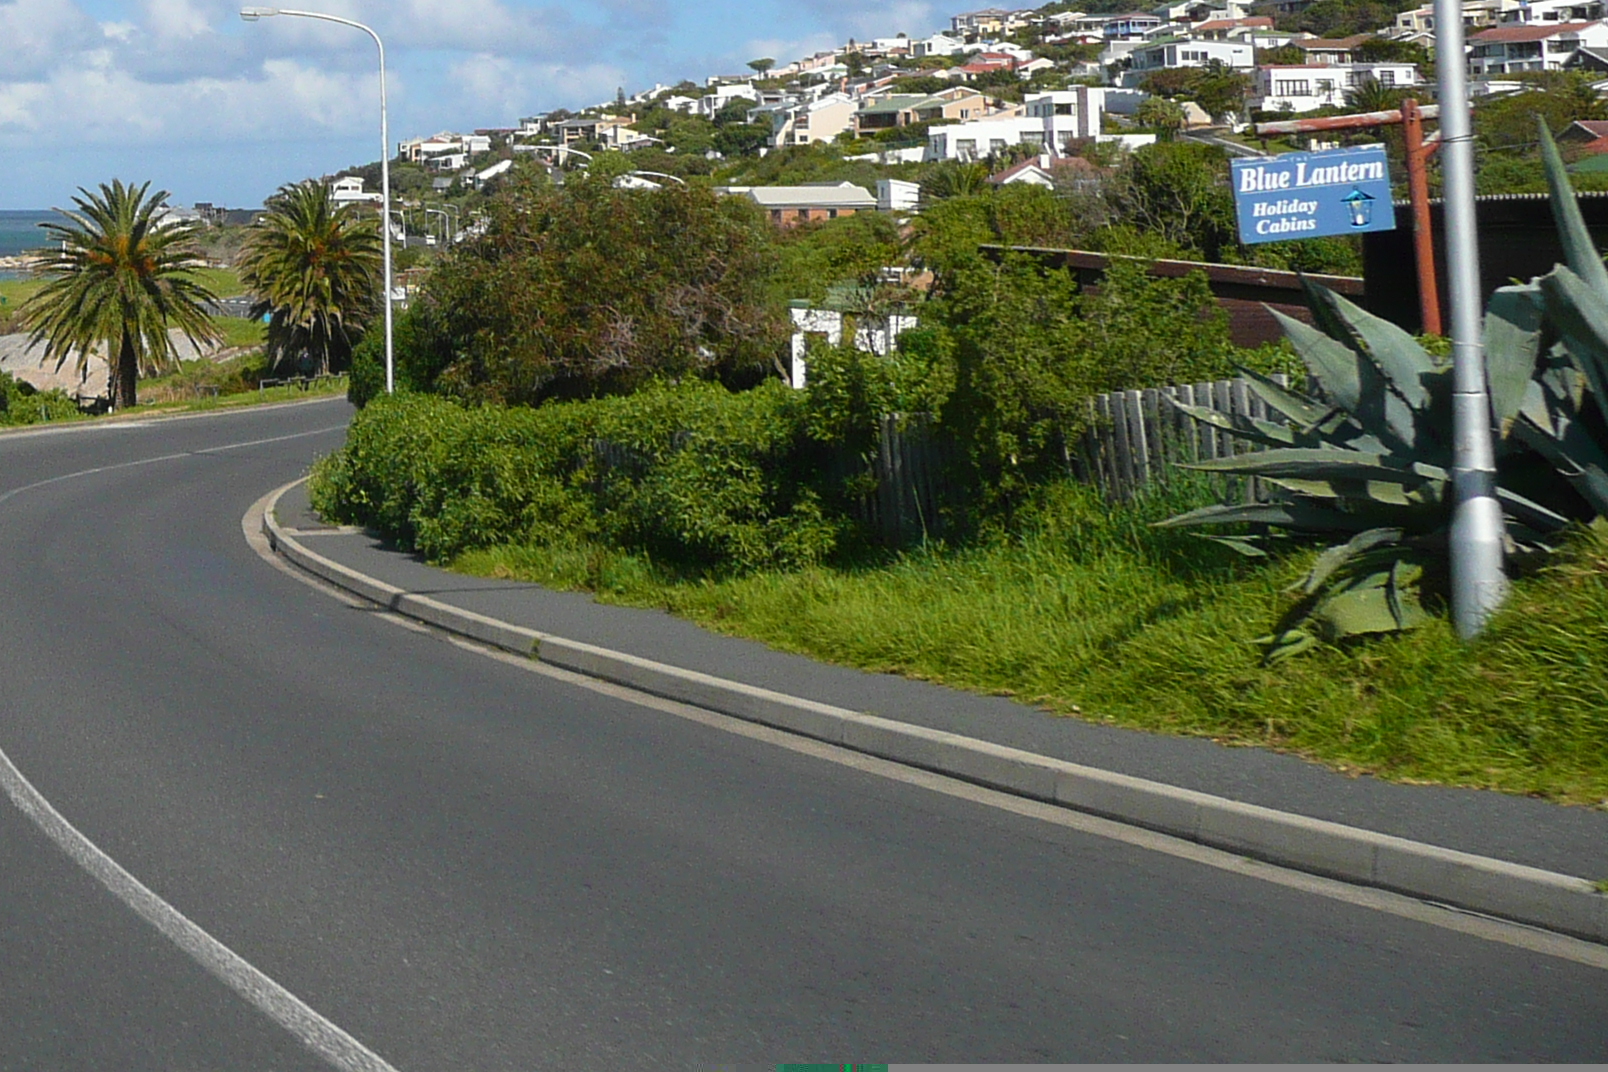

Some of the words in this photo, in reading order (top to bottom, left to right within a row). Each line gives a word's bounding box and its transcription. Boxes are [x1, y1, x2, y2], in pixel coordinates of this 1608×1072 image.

[1240, 167, 1290, 192] Blue
[1296, 161, 1383, 186] Lantern
[1253, 199, 1317, 217] Holiday
[1256, 217, 1316, 235] Cabins
